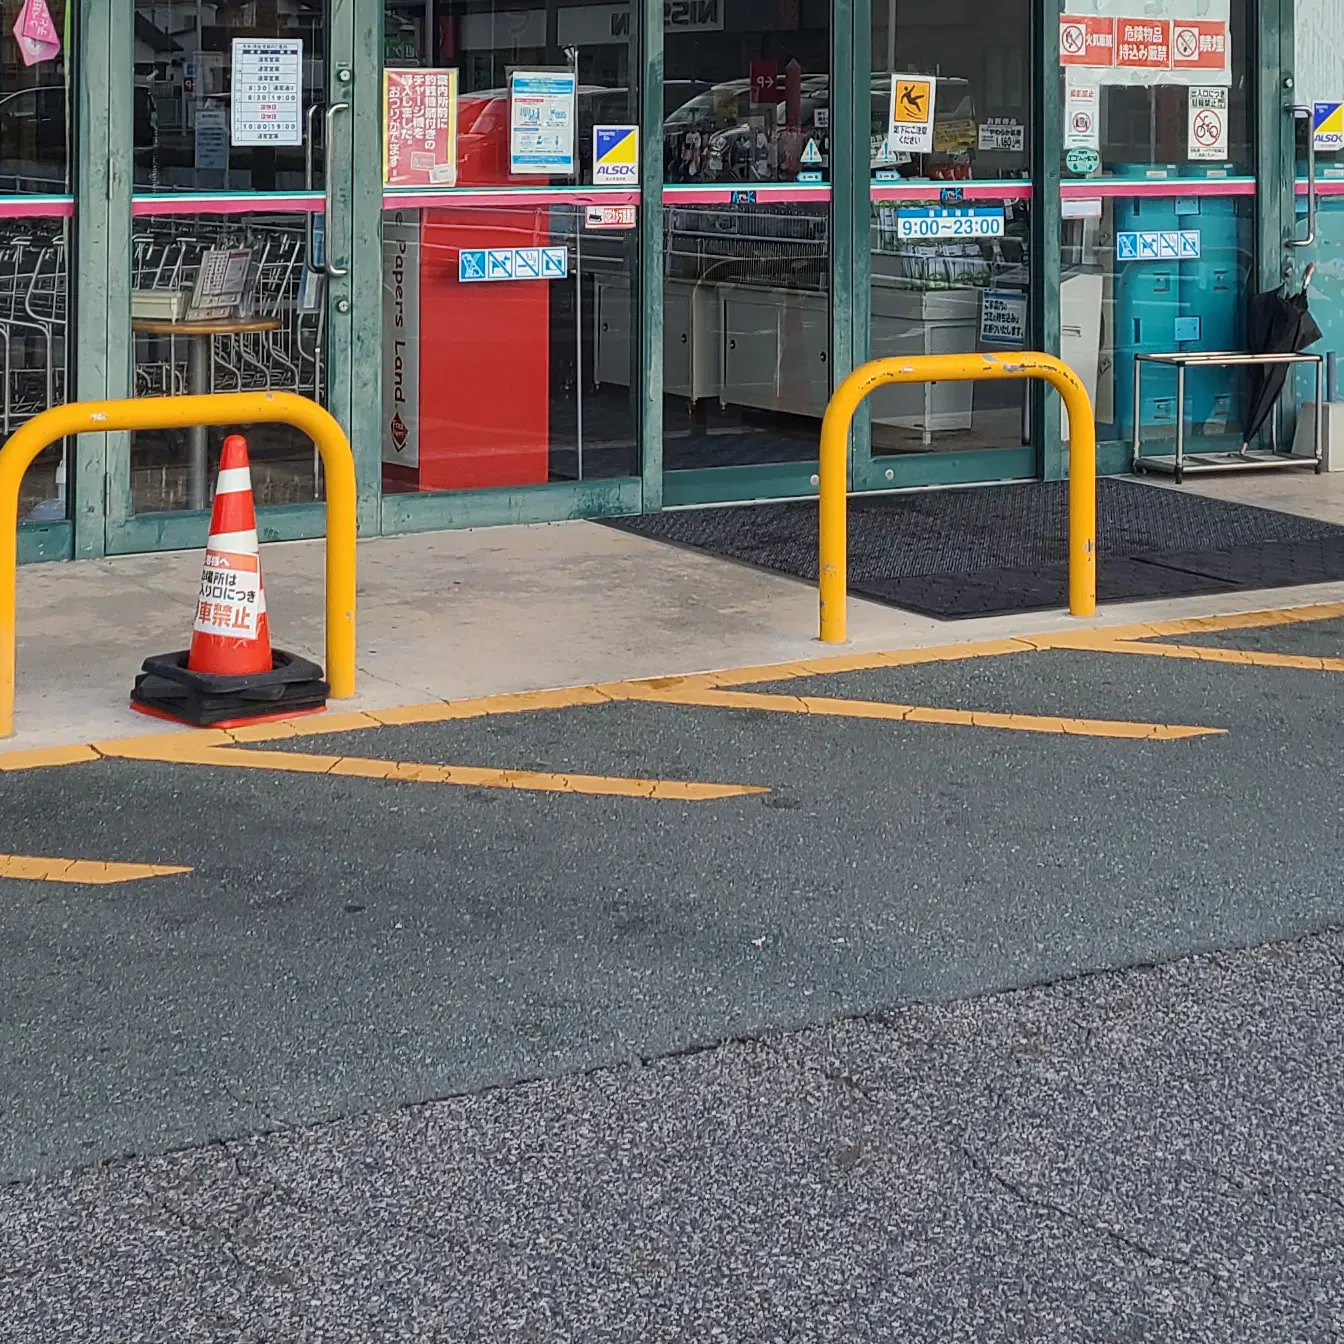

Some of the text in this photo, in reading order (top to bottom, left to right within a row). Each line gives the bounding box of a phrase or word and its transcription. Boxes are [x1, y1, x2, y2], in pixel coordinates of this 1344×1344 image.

[1124, 24, 1164, 44] 危険物品
[1199, 34, 1226, 52] 禁煙
[1119, 43, 1168, 61] 持込み厳禁
[898, 136, 922, 145] ください
[1313, 133, 1344, 143] ALSOK
[596, 165, 636, 175] ALSOK
[902, 218, 1000, 236] 9:00～23:00
[392, 239, 406, 329] Papers
